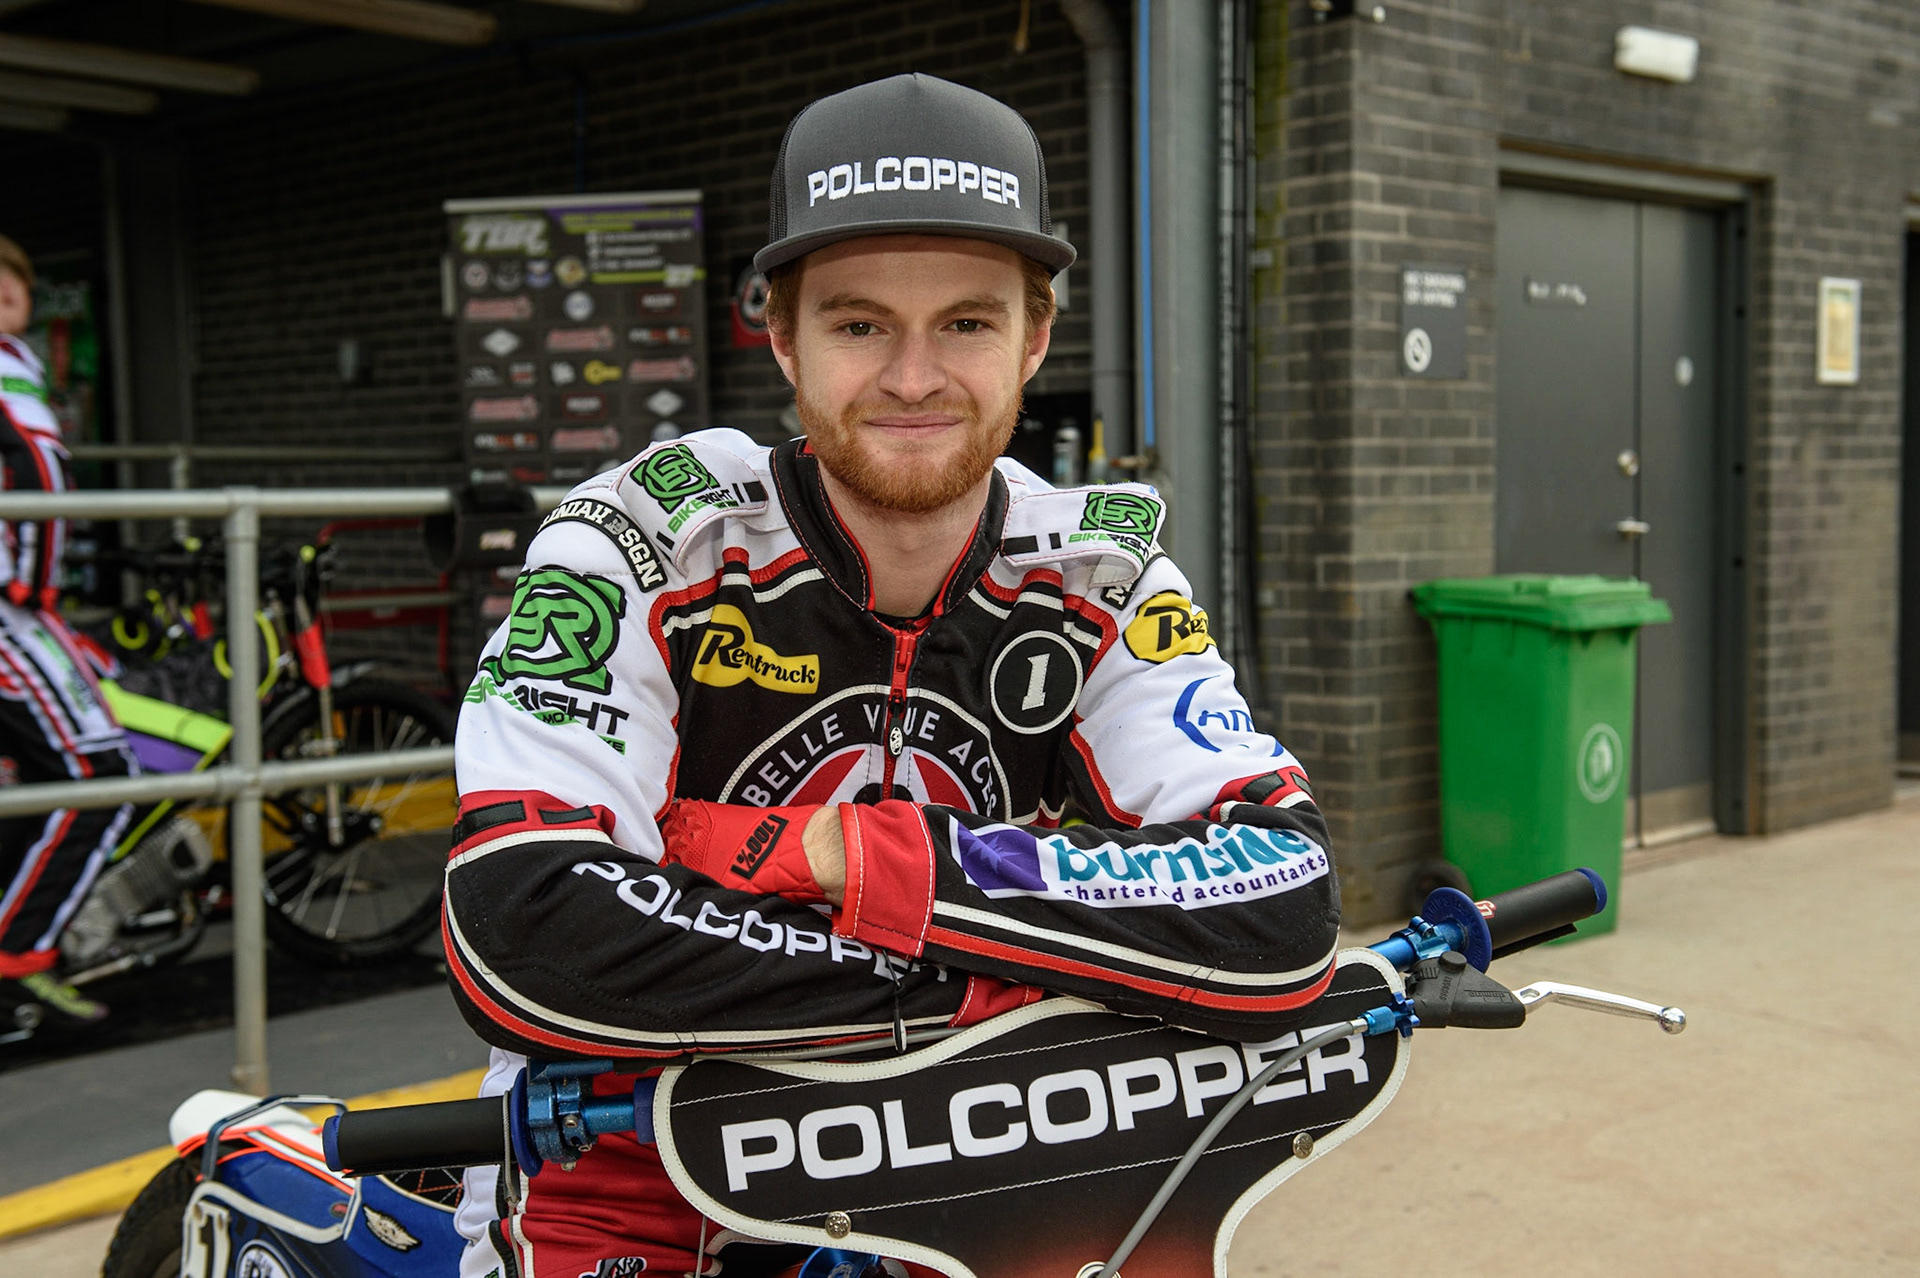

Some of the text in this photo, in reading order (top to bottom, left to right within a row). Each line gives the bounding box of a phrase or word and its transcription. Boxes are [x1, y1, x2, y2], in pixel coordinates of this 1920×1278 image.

[807, 156, 1021, 209] POLCOPPER
[698, 623, 816, 685] Rentruck
[1021, 652, 1051, 711] 1
[741, 713, 844, 807] BELLE
[1049, 825, 1311, 885] burnside
[1194, 852, 1326, 900] accountants
[722, 1023, 1370, 1193] POLCOPPER
